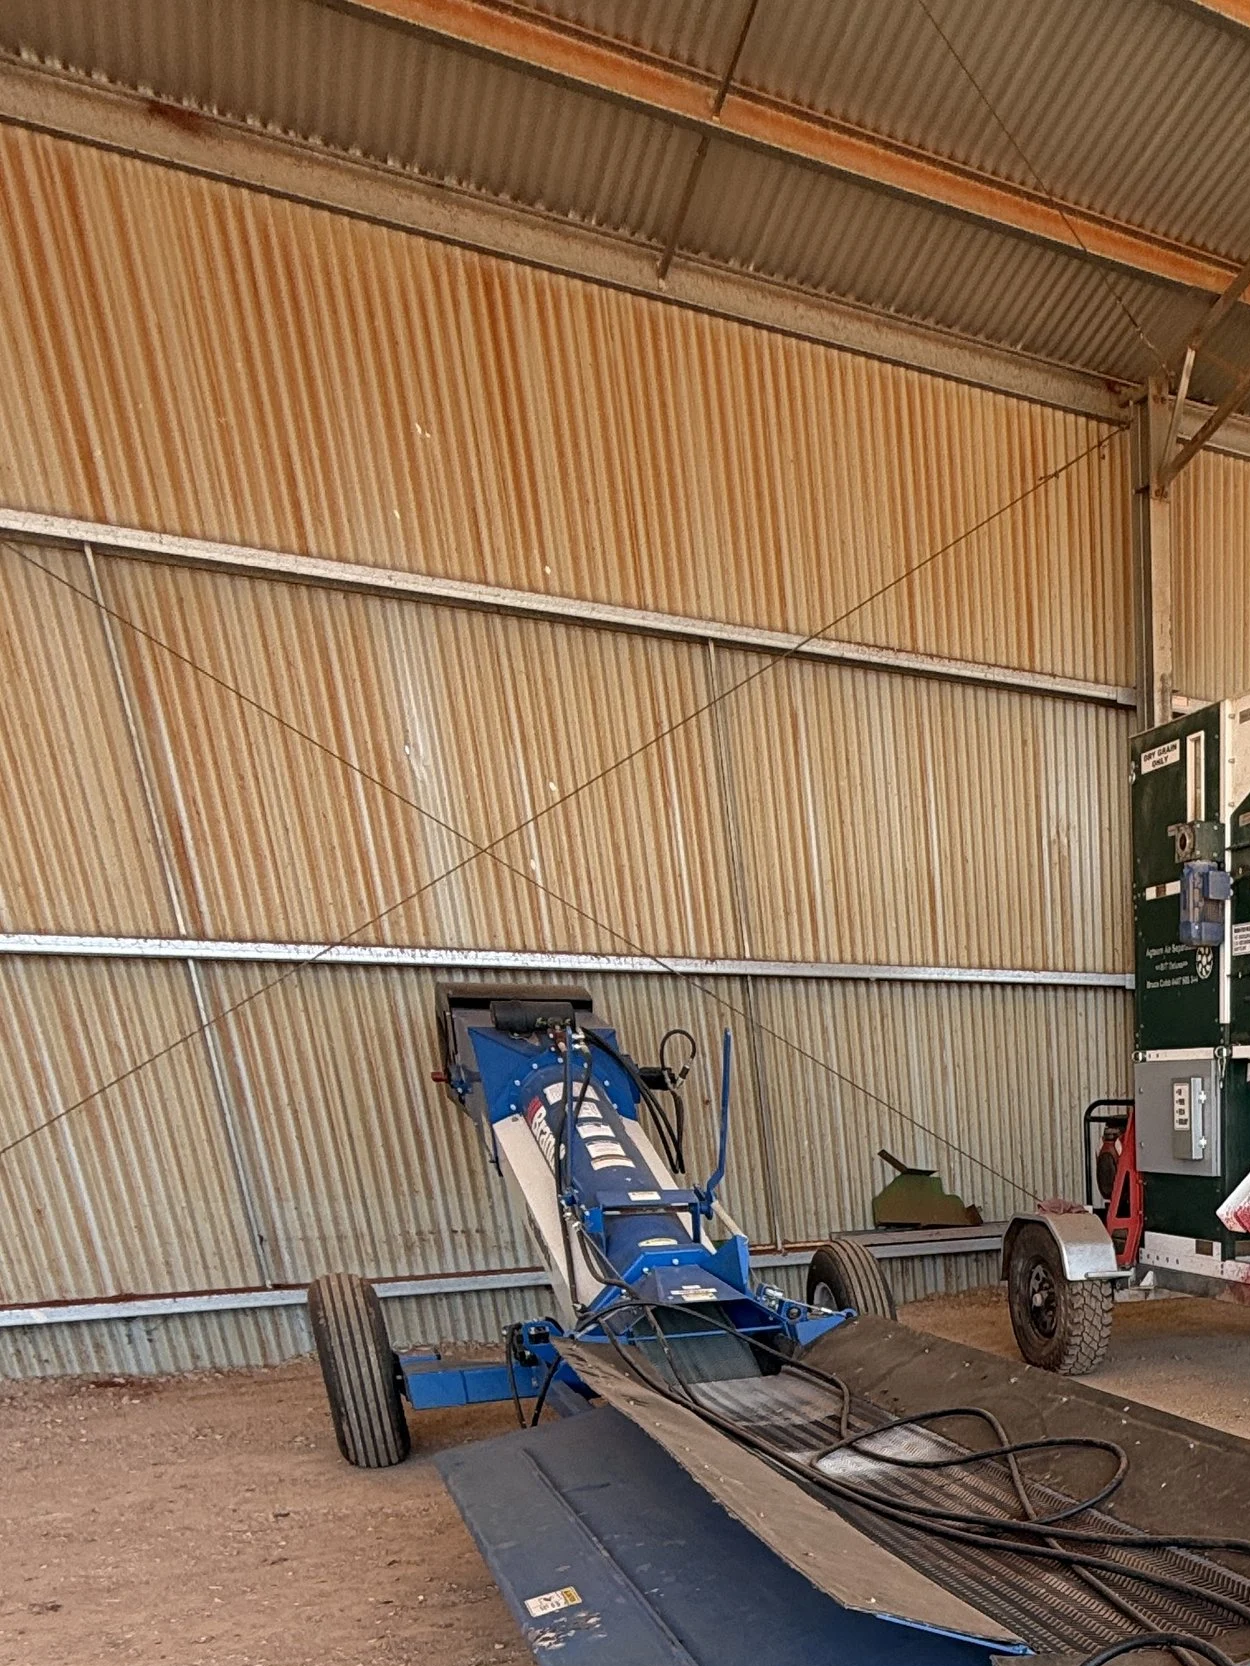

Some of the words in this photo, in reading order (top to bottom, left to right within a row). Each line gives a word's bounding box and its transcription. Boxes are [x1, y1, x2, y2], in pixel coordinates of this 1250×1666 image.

[1143, 751, 1155, 762] DRY
[1157, 743, 1178, 757] GRAIN
[1151, 755, 1169, 768] ONLY
